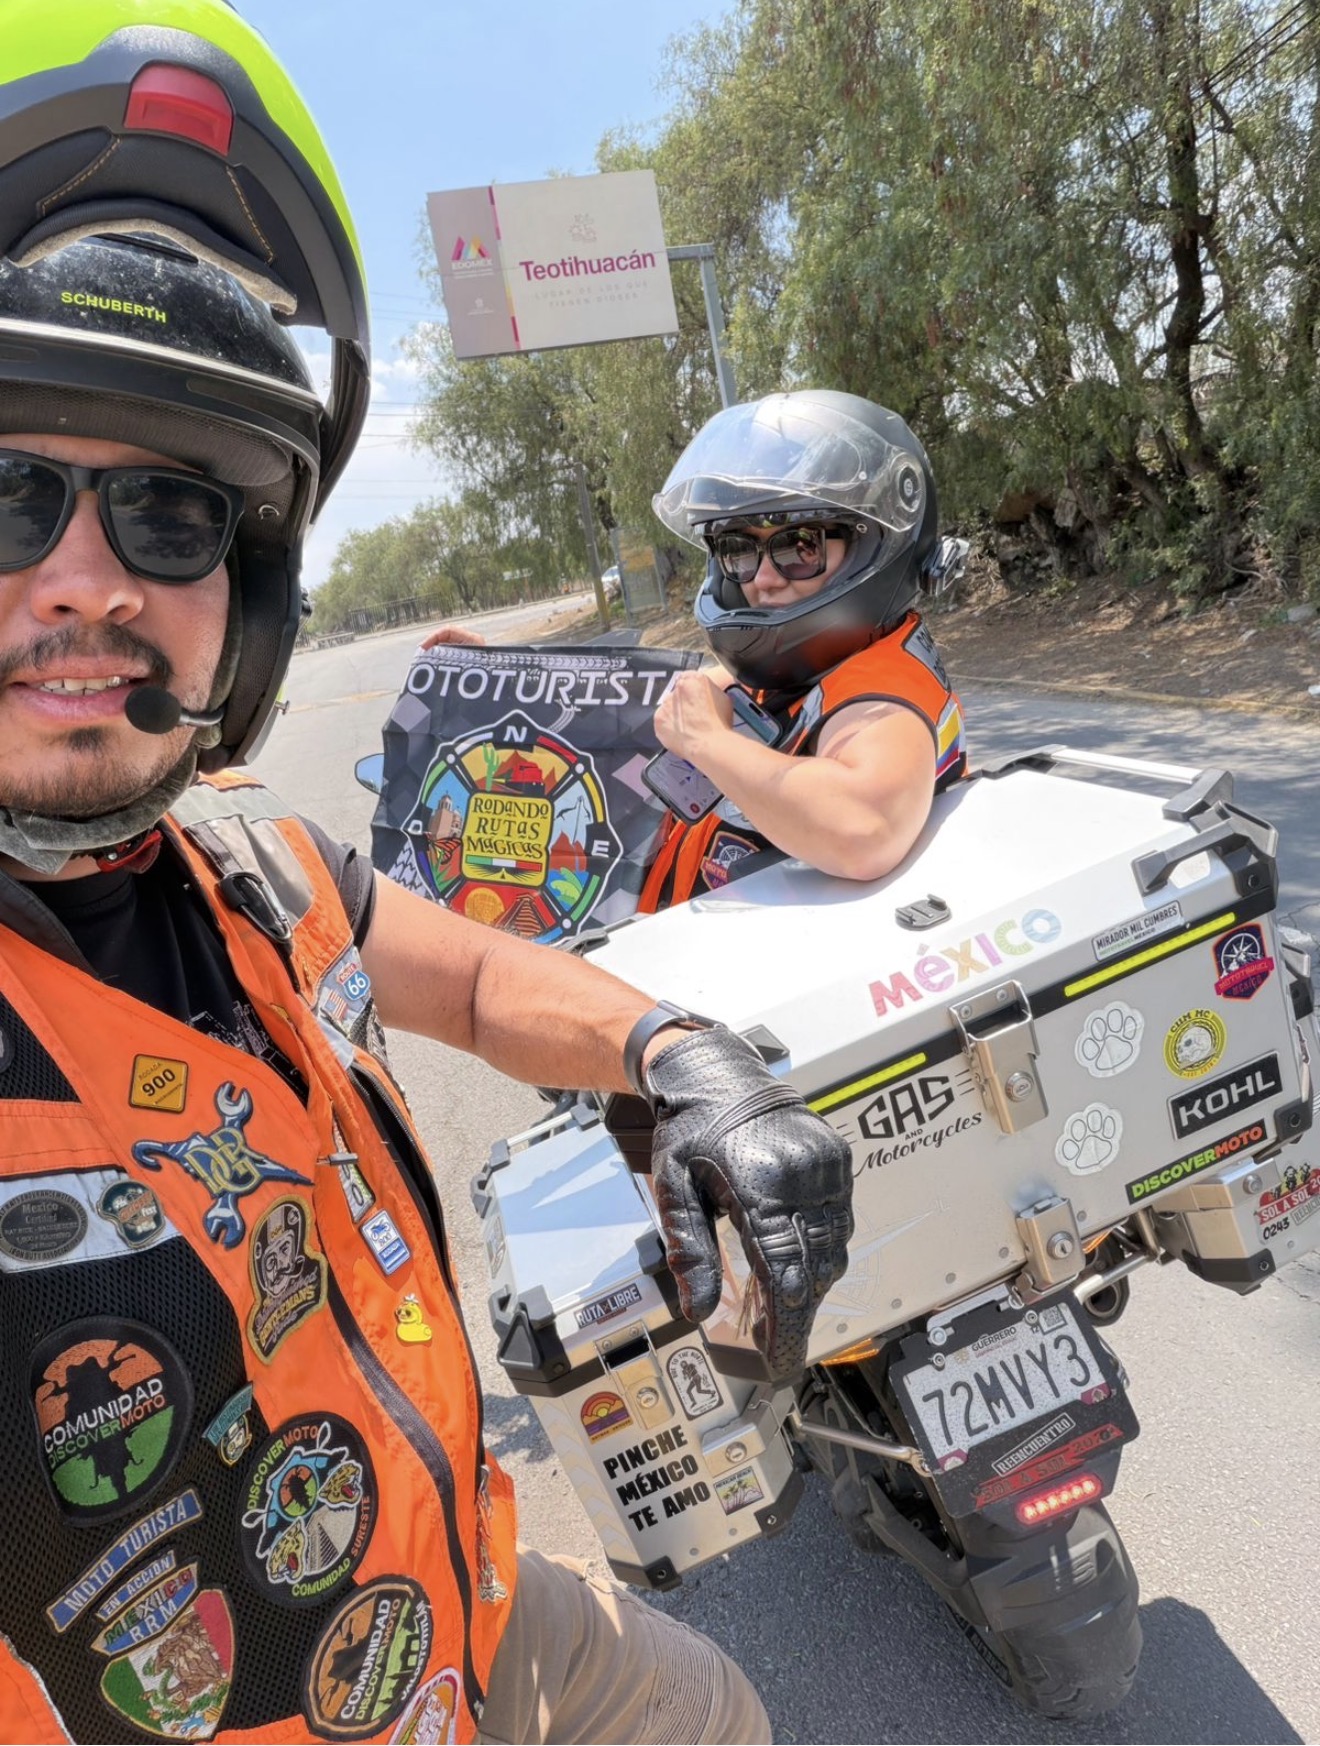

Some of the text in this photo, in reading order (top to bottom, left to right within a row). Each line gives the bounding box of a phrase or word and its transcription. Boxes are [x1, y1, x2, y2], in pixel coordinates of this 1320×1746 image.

[520, 249, 656, 282] Teotihuacán
[61, 291, 167, 323] SCHUBERTH
[402, 663, 680, 707] OTOTURIST
[503, 725, 528, 743] N
[591, 840, 611, 858] E
[1096, 905, 1178, 950] MIRADOR MIL CUMBRES
[348, 973, 366, 996] 66
[142, 1068, 175, 1097] 900
[857, 1076, 955, 1139] GAS
[1179, 1066, 1276, 1126] KOHL
[853, 1112, 982, 1177] Motorcycles
[904, 1128, 924, 1140] AND
[1131, 1125, 1264, 1198] DISCOVERMOTO
[1261, 1204, 1283, 1222] SOL
[1283, 1199, 1291, 1211] A
[1291, 1188, 1311, 1206] SOL
[1263, 1217, 1290, 1240] 0243
[575, 1303, 605, 1327] RUTA
[606, 1286, 640, 1311] LIBRE
[971, 1326, 1017, 1351] GUERRERO
[44, 1378, 164, 1454] COMUNIDAD
[921, 1334, 1091, 1446] 72MVY3
[49, 1394, 166, 1469] DISCOVERMOTO
[603, 1425, 689, 1480] PINCHE
[996, 1419, 1072, 1474] REENCUENTRO
[246, 1425, 319, 1510] DISCOVERMOTO
[616, 1454, 699, 1506] MÉXICO
[351, 1496, 370, 1557] SURESTE
[628, 1481, 711, 1532] TE AMO
[64, 1499, 187, 1614] MOTO TURISTA
[292, 1557, 351, 1597] COMUNIDAD
[105, 1556, 170, 1616] EN ACCION
[340, 1598, 391, 1720] COMUNIDAD
[355, 1598, 400, 1721] DISCOVERMOTO
